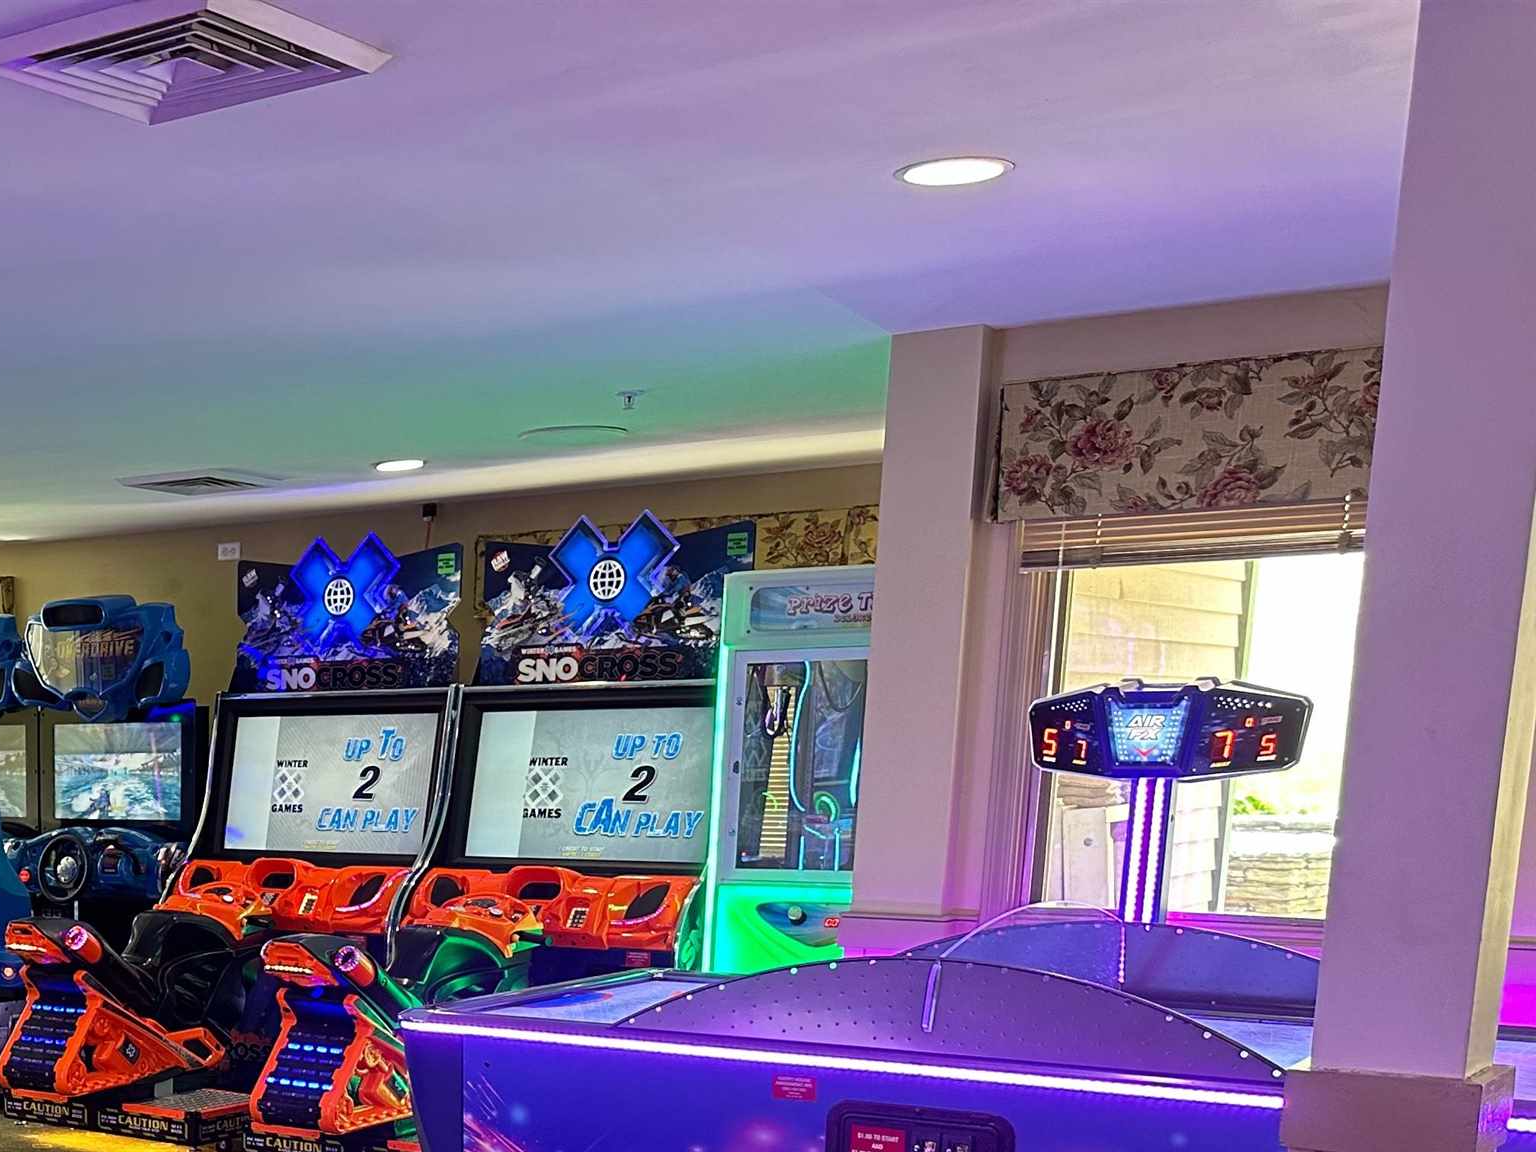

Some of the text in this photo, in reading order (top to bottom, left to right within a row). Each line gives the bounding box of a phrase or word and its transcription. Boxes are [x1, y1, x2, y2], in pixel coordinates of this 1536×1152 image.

[1126, 715, 1166, 728] AIR
[344, 737, 372, 761] UP
[613, 731, 683, 760] UP TO
[1042, 728, 1058, 756] 5
[1076, 740, 1087, 759] 7
[1214, 730, 1233, 759] 7
[1259, 734, 1277, 755] 5
[276, 760, 309, 769] WINTER
[529, 756, 569, 767] WINTER
[352, 765, 381, 801] 2
[621, 764, 658, 803] 2
[271, 804, 304, 813] GAMES
[522, 808, 562, 819] GAMES
[573, 798, 705, 839] CAN PLAY
[316, 807, 419, 833] CAN PLAY
[23, 1101, 70, 1117] CAUTION
[117, 1114, 169, 1131] CAUTION
